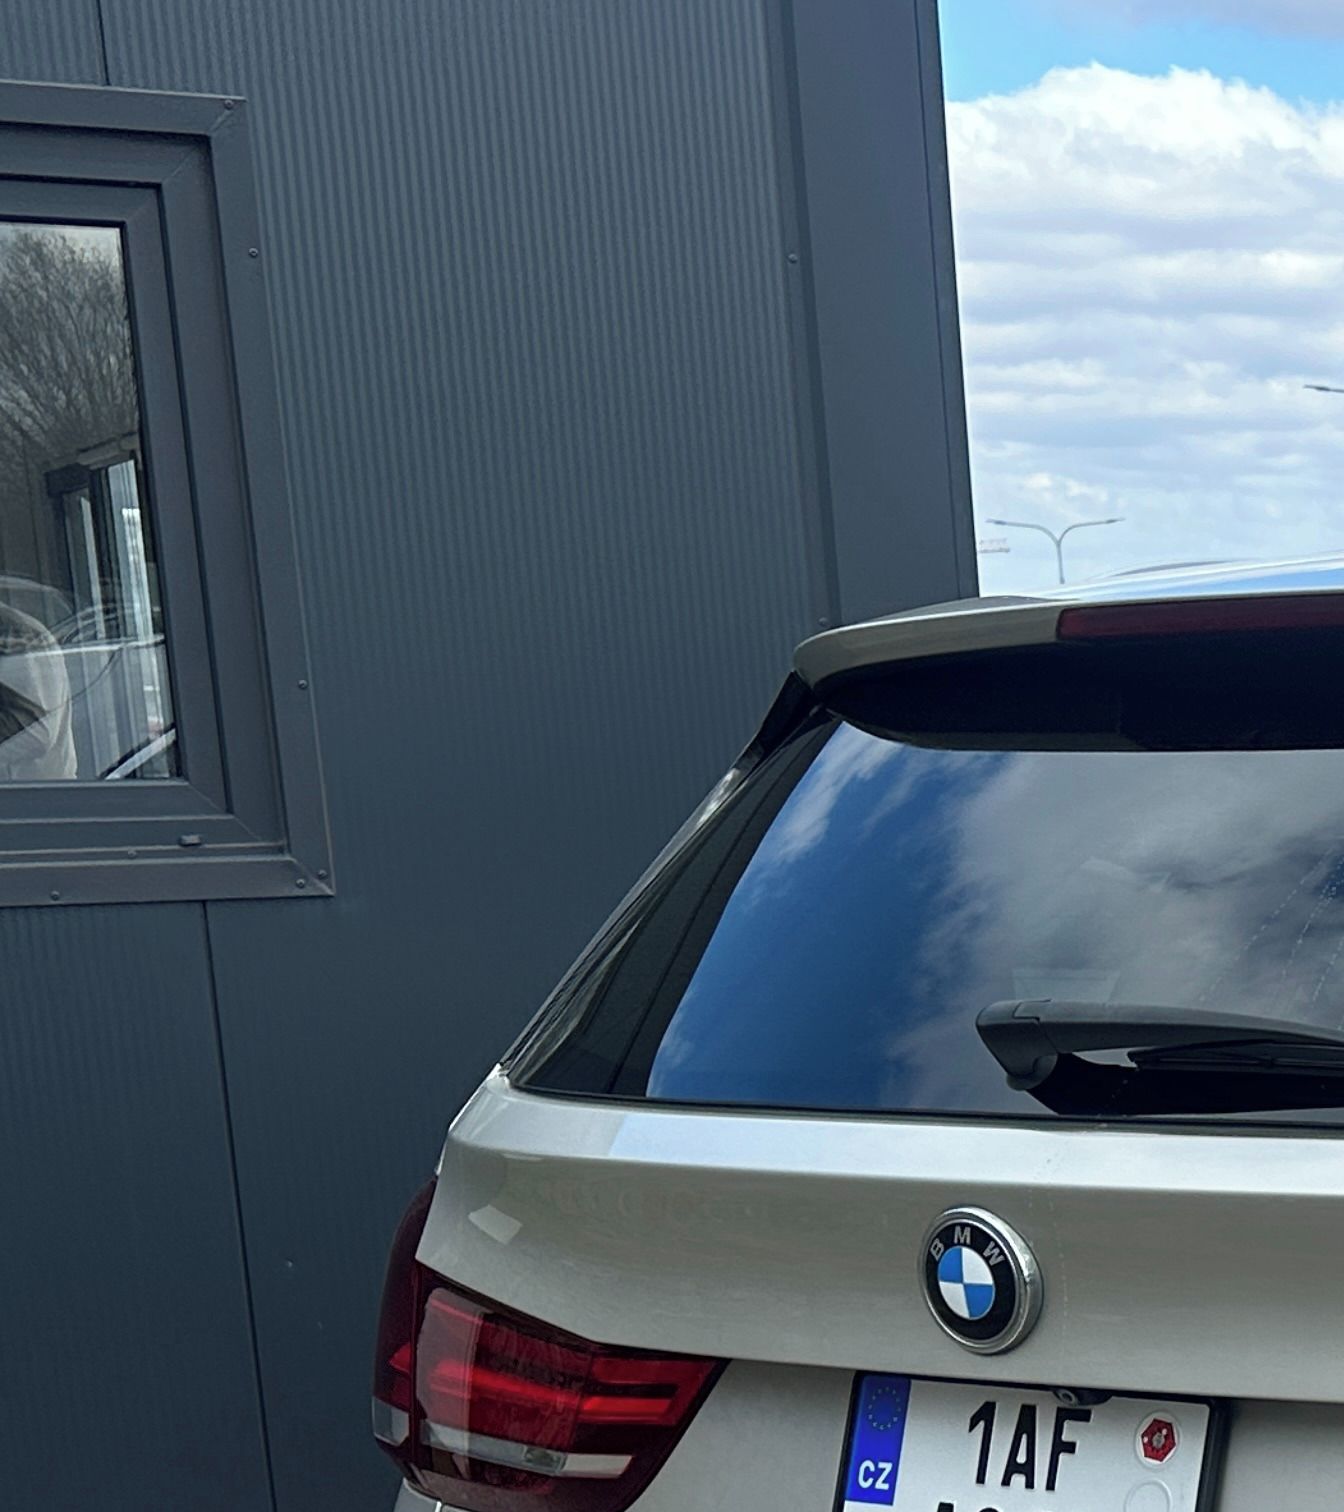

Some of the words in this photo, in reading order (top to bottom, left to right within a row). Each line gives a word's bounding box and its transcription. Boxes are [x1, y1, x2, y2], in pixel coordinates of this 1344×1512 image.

[930, 1226, 1004, 1266] BMW
[969, 1400, 1092, 1491] 1AF
[858, 1459, 893, 1490] CZ
